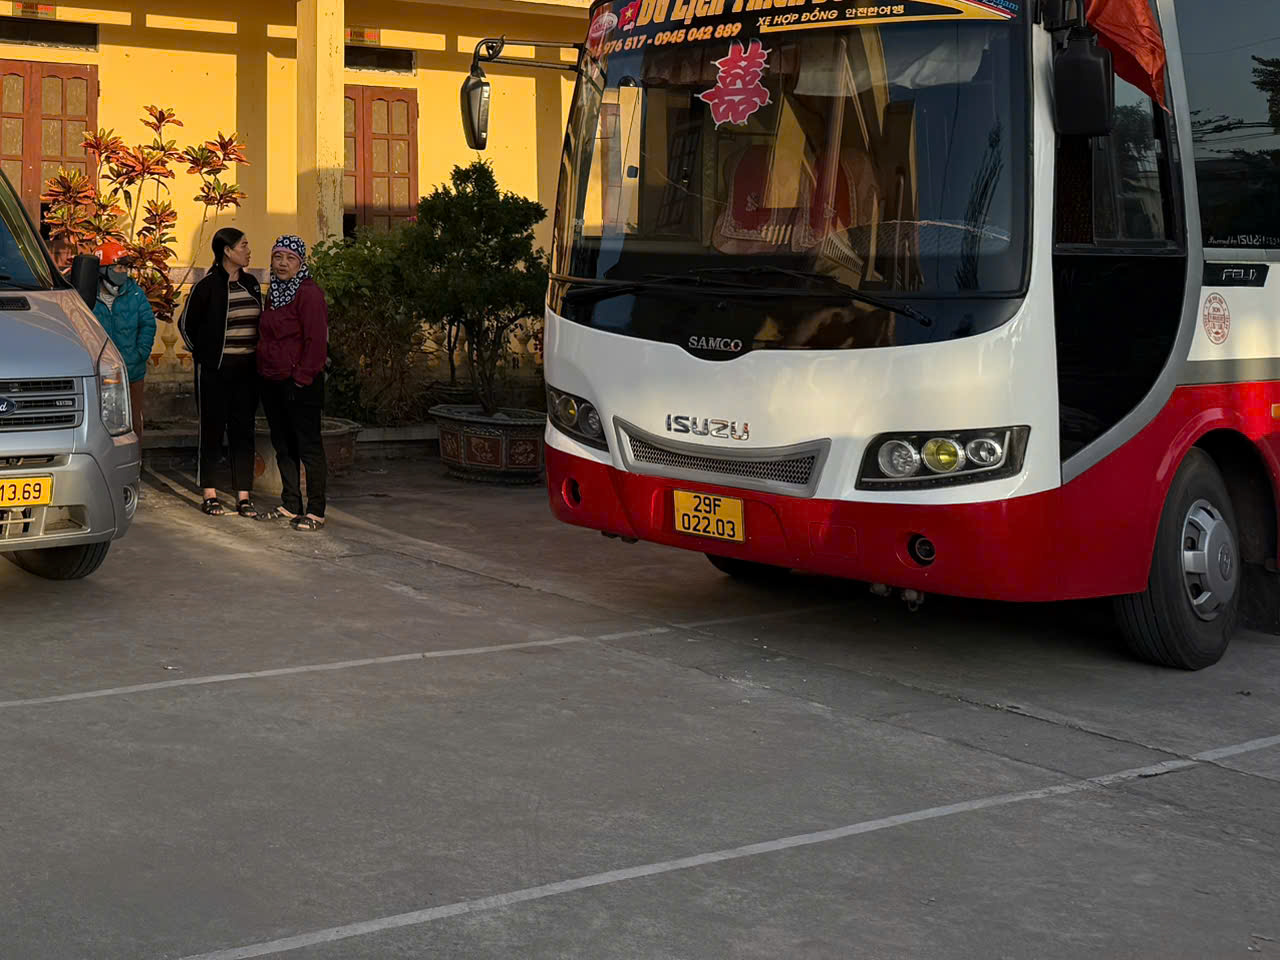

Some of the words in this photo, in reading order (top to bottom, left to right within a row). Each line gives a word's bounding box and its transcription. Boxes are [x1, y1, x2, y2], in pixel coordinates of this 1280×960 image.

[756, 16, 771, 27] XE
[773, 13, 799, 26] HỢP
[687, 25, 714, 42] 042
[714, 22, 742, 38] 889
[688, 336, 742, 352] SAMCO
[665, 414, 750, 441] ISUZU
[693, 495, 722, 515] 29F
[681, 513, 736, 538] 022.03
